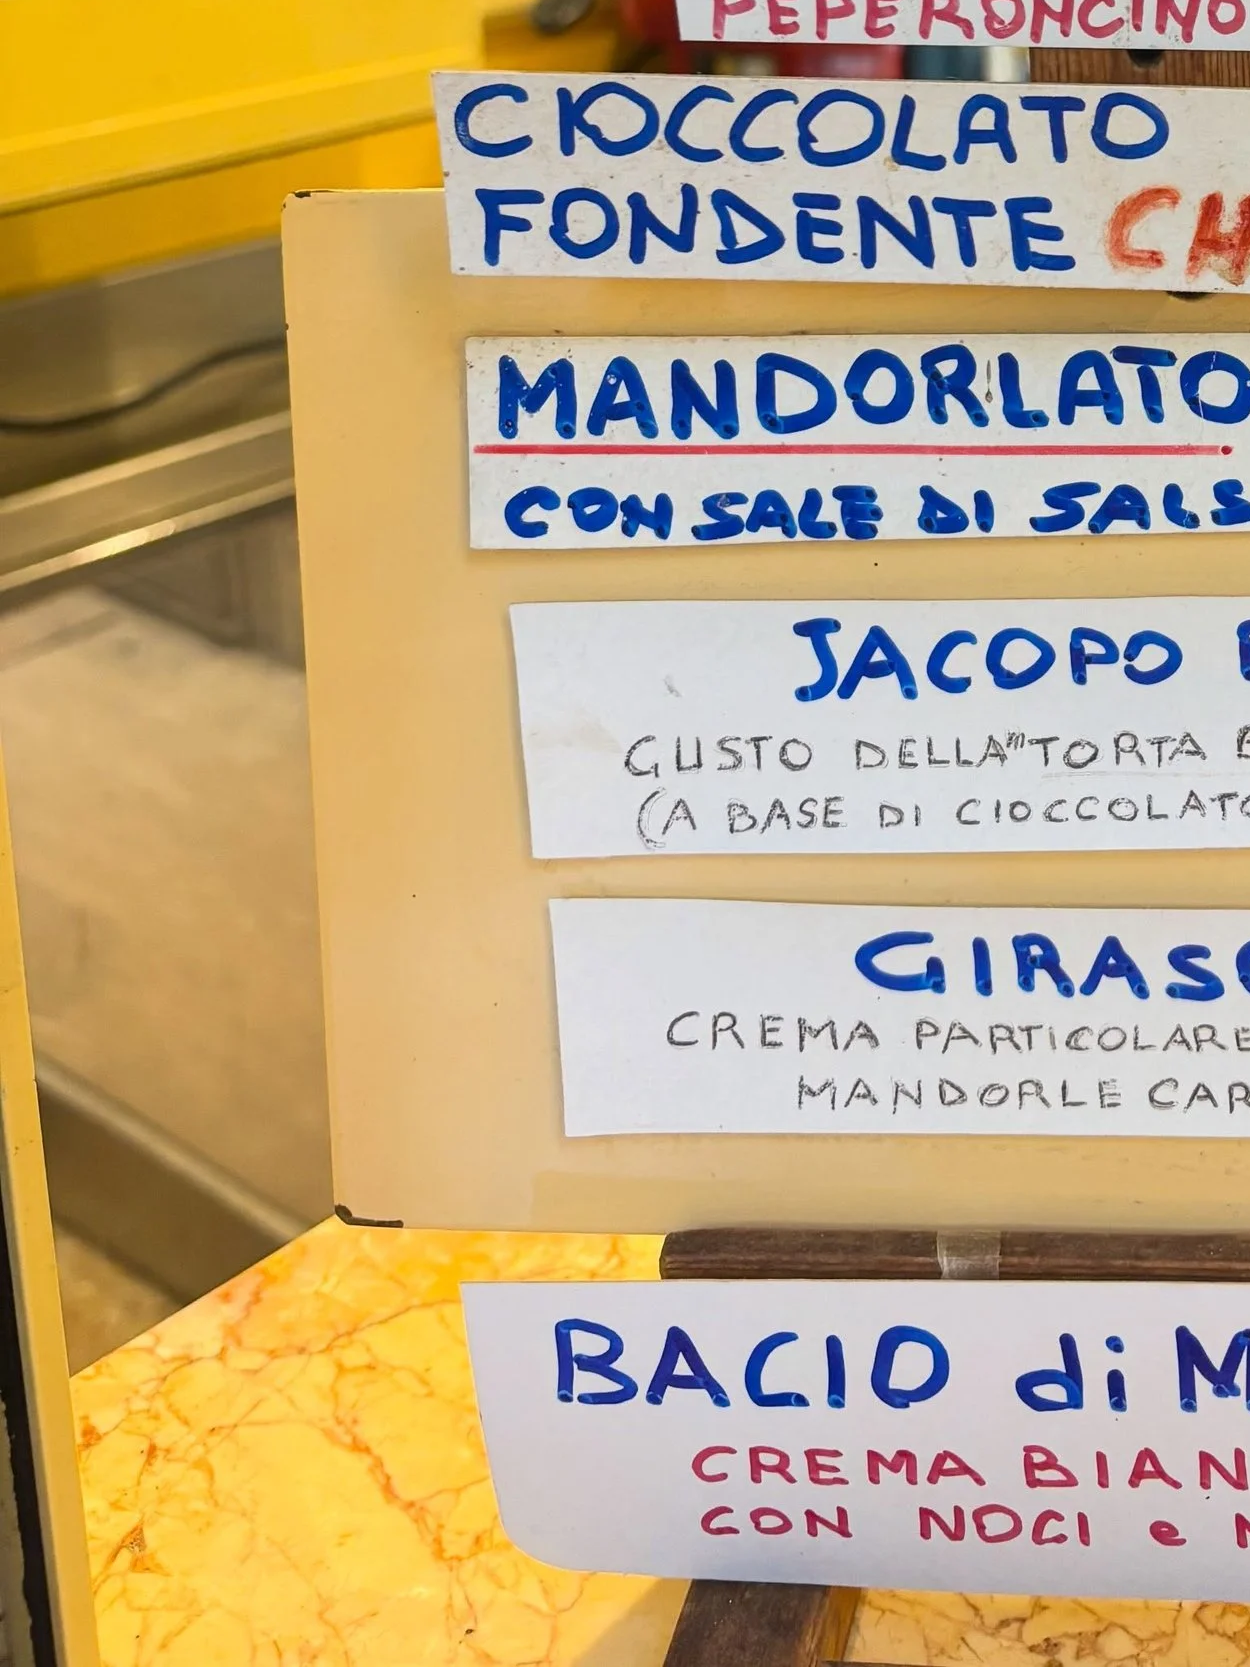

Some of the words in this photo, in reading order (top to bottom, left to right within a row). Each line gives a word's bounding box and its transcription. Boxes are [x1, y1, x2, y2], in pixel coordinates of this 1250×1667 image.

[453, 80, 1170, 172] CIOCCOLATO
[474, 182, 1077, 271] FONDENTE
[503, 484, 672, 541] CON
[690, 483, 885, 541] SALE
[917, 484, 994, 535] DI
[792, 617, 1184, 703] JACOPO
[624, 733, 814, 779] GUSTO
[637, 786, 699, 850] (A
[726, 795, 847, 835] BASE
[879, 802, 922, 829] DI
[665, 1010, 882, 1052] CREMA
[797, 1074, 1123, 1114] MANDORLE
[553, 1317, 952, 1410] BACIO
[1015, 1332, 1130, 1413] di
[691, 1444, 989, 1488] CREMA
[700, 1504, 853, 1540] CON
[918, 1503, 1092, 1548] NOCI
[1149, 1520, 1187, 1548] e
